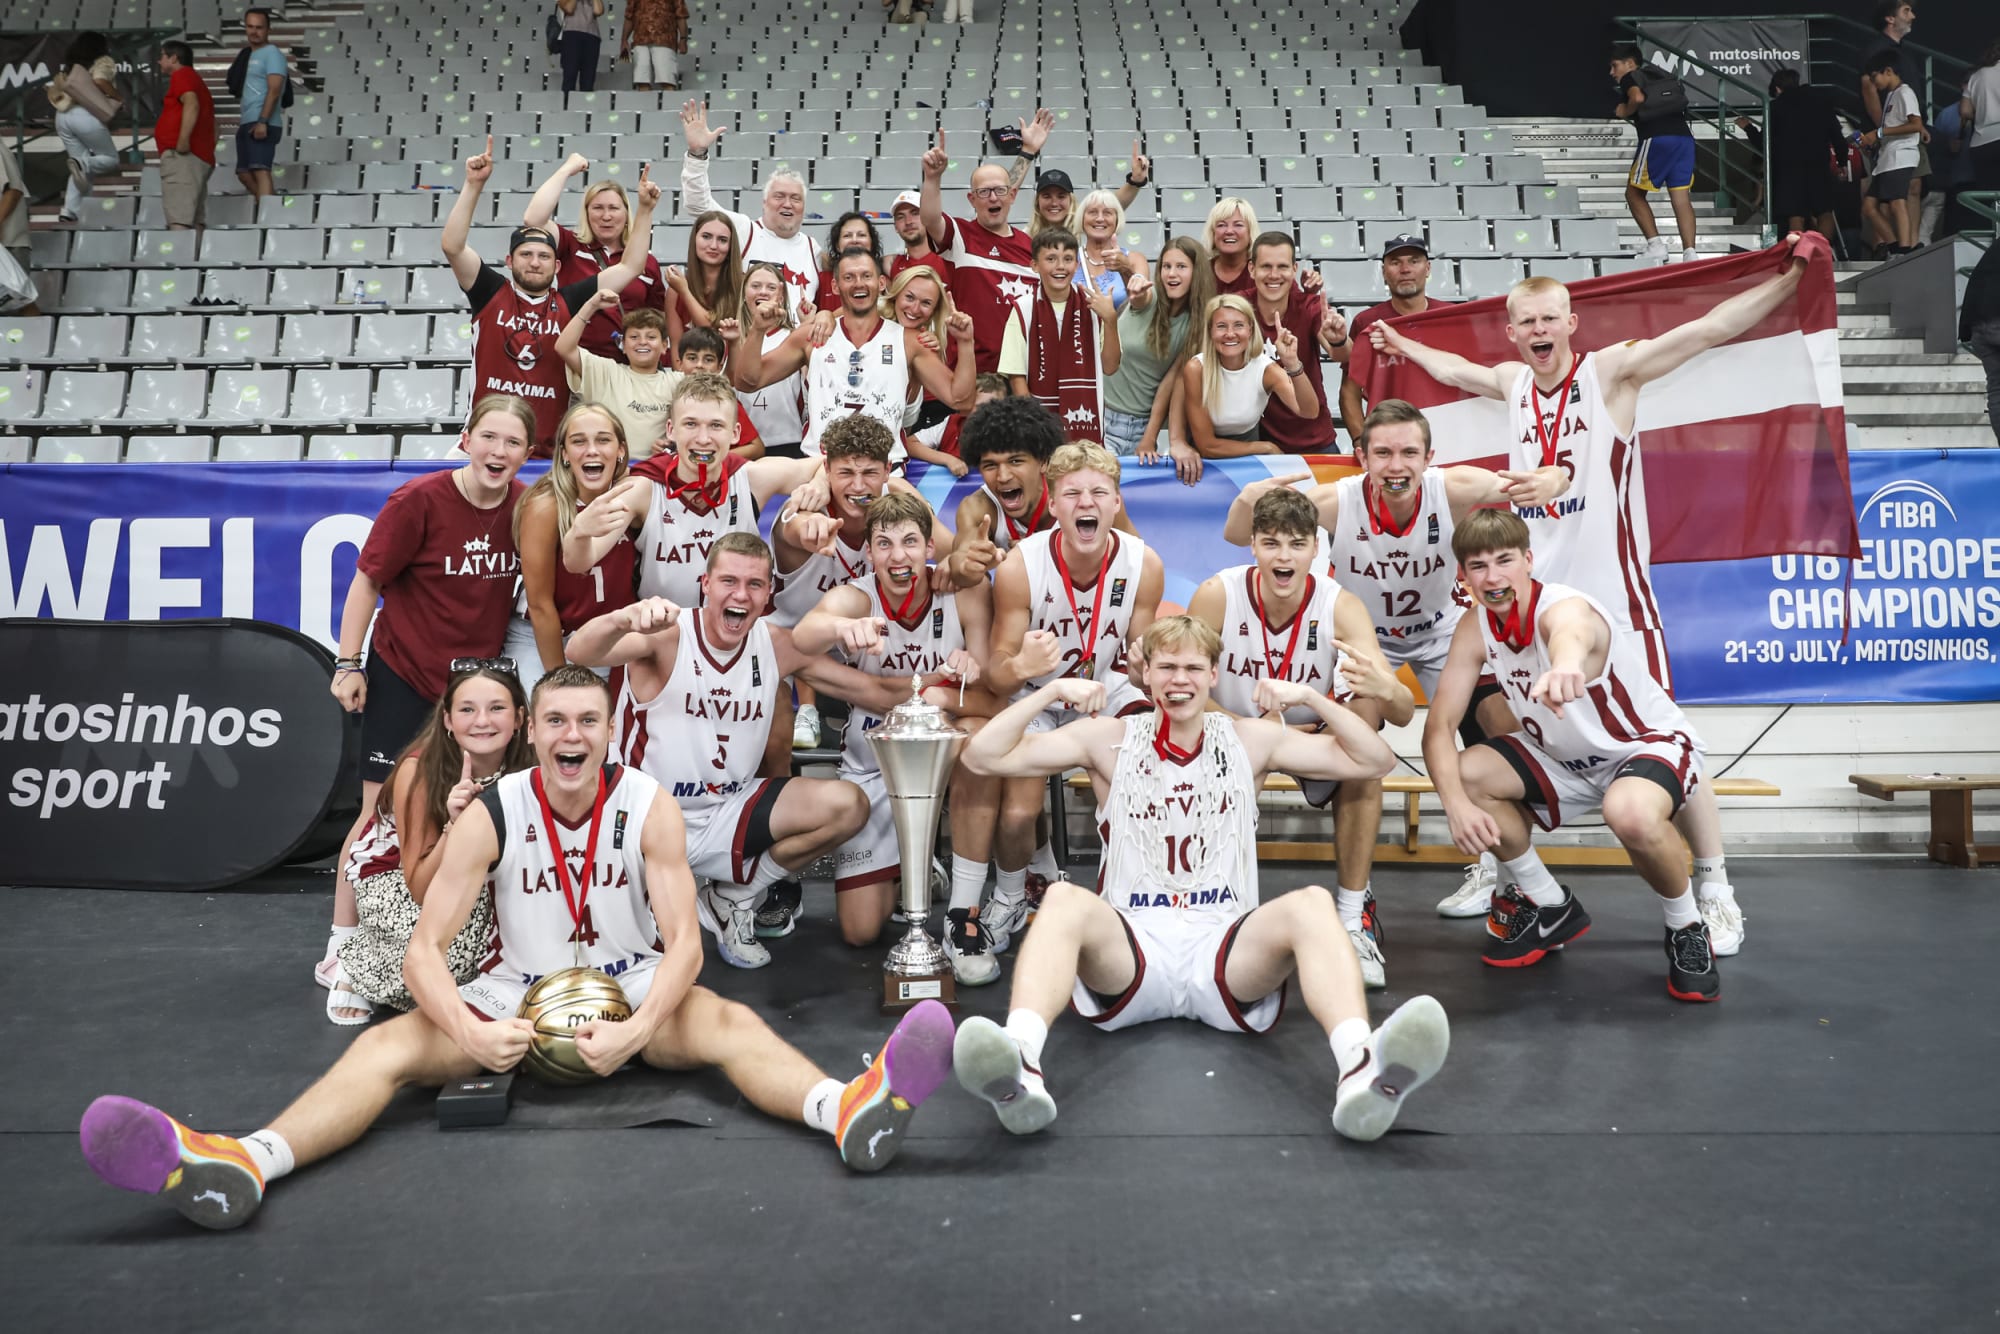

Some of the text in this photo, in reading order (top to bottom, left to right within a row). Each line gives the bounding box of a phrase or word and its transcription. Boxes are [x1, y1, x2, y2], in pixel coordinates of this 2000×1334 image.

[1709, 47, 1800, 60] matosinhos
[497, 309, 561, 336] LATVIJA
[517, 344, 536, 371] 6
[486, 376, 556, 399] MAXIMA
[752, 390, 769, 412] 4
[1879, 500, 1936, 529] FIBA
[444, 552, 521, 576] LATVIJ
[1350, 553, 1446, 580] LATVIJA
[1380, 589, 1422, 618] 12
[1768, 587, 2000, 630] CHAMPIONS
[1374, 609, 1445, 640] AXIMA
[1724, 637, 1997, 665] 21-30 JULY, MATOSINHOS,
[711, 733, 731, 770] 5
[8, 761, 172, 819] sport
[839, 848, 873, 865] Balcia
[1165, 834, 1207, 875] 10
[1129, 884, 1239, 910] MAXIMA
[567, 903, 600, 948] 4
